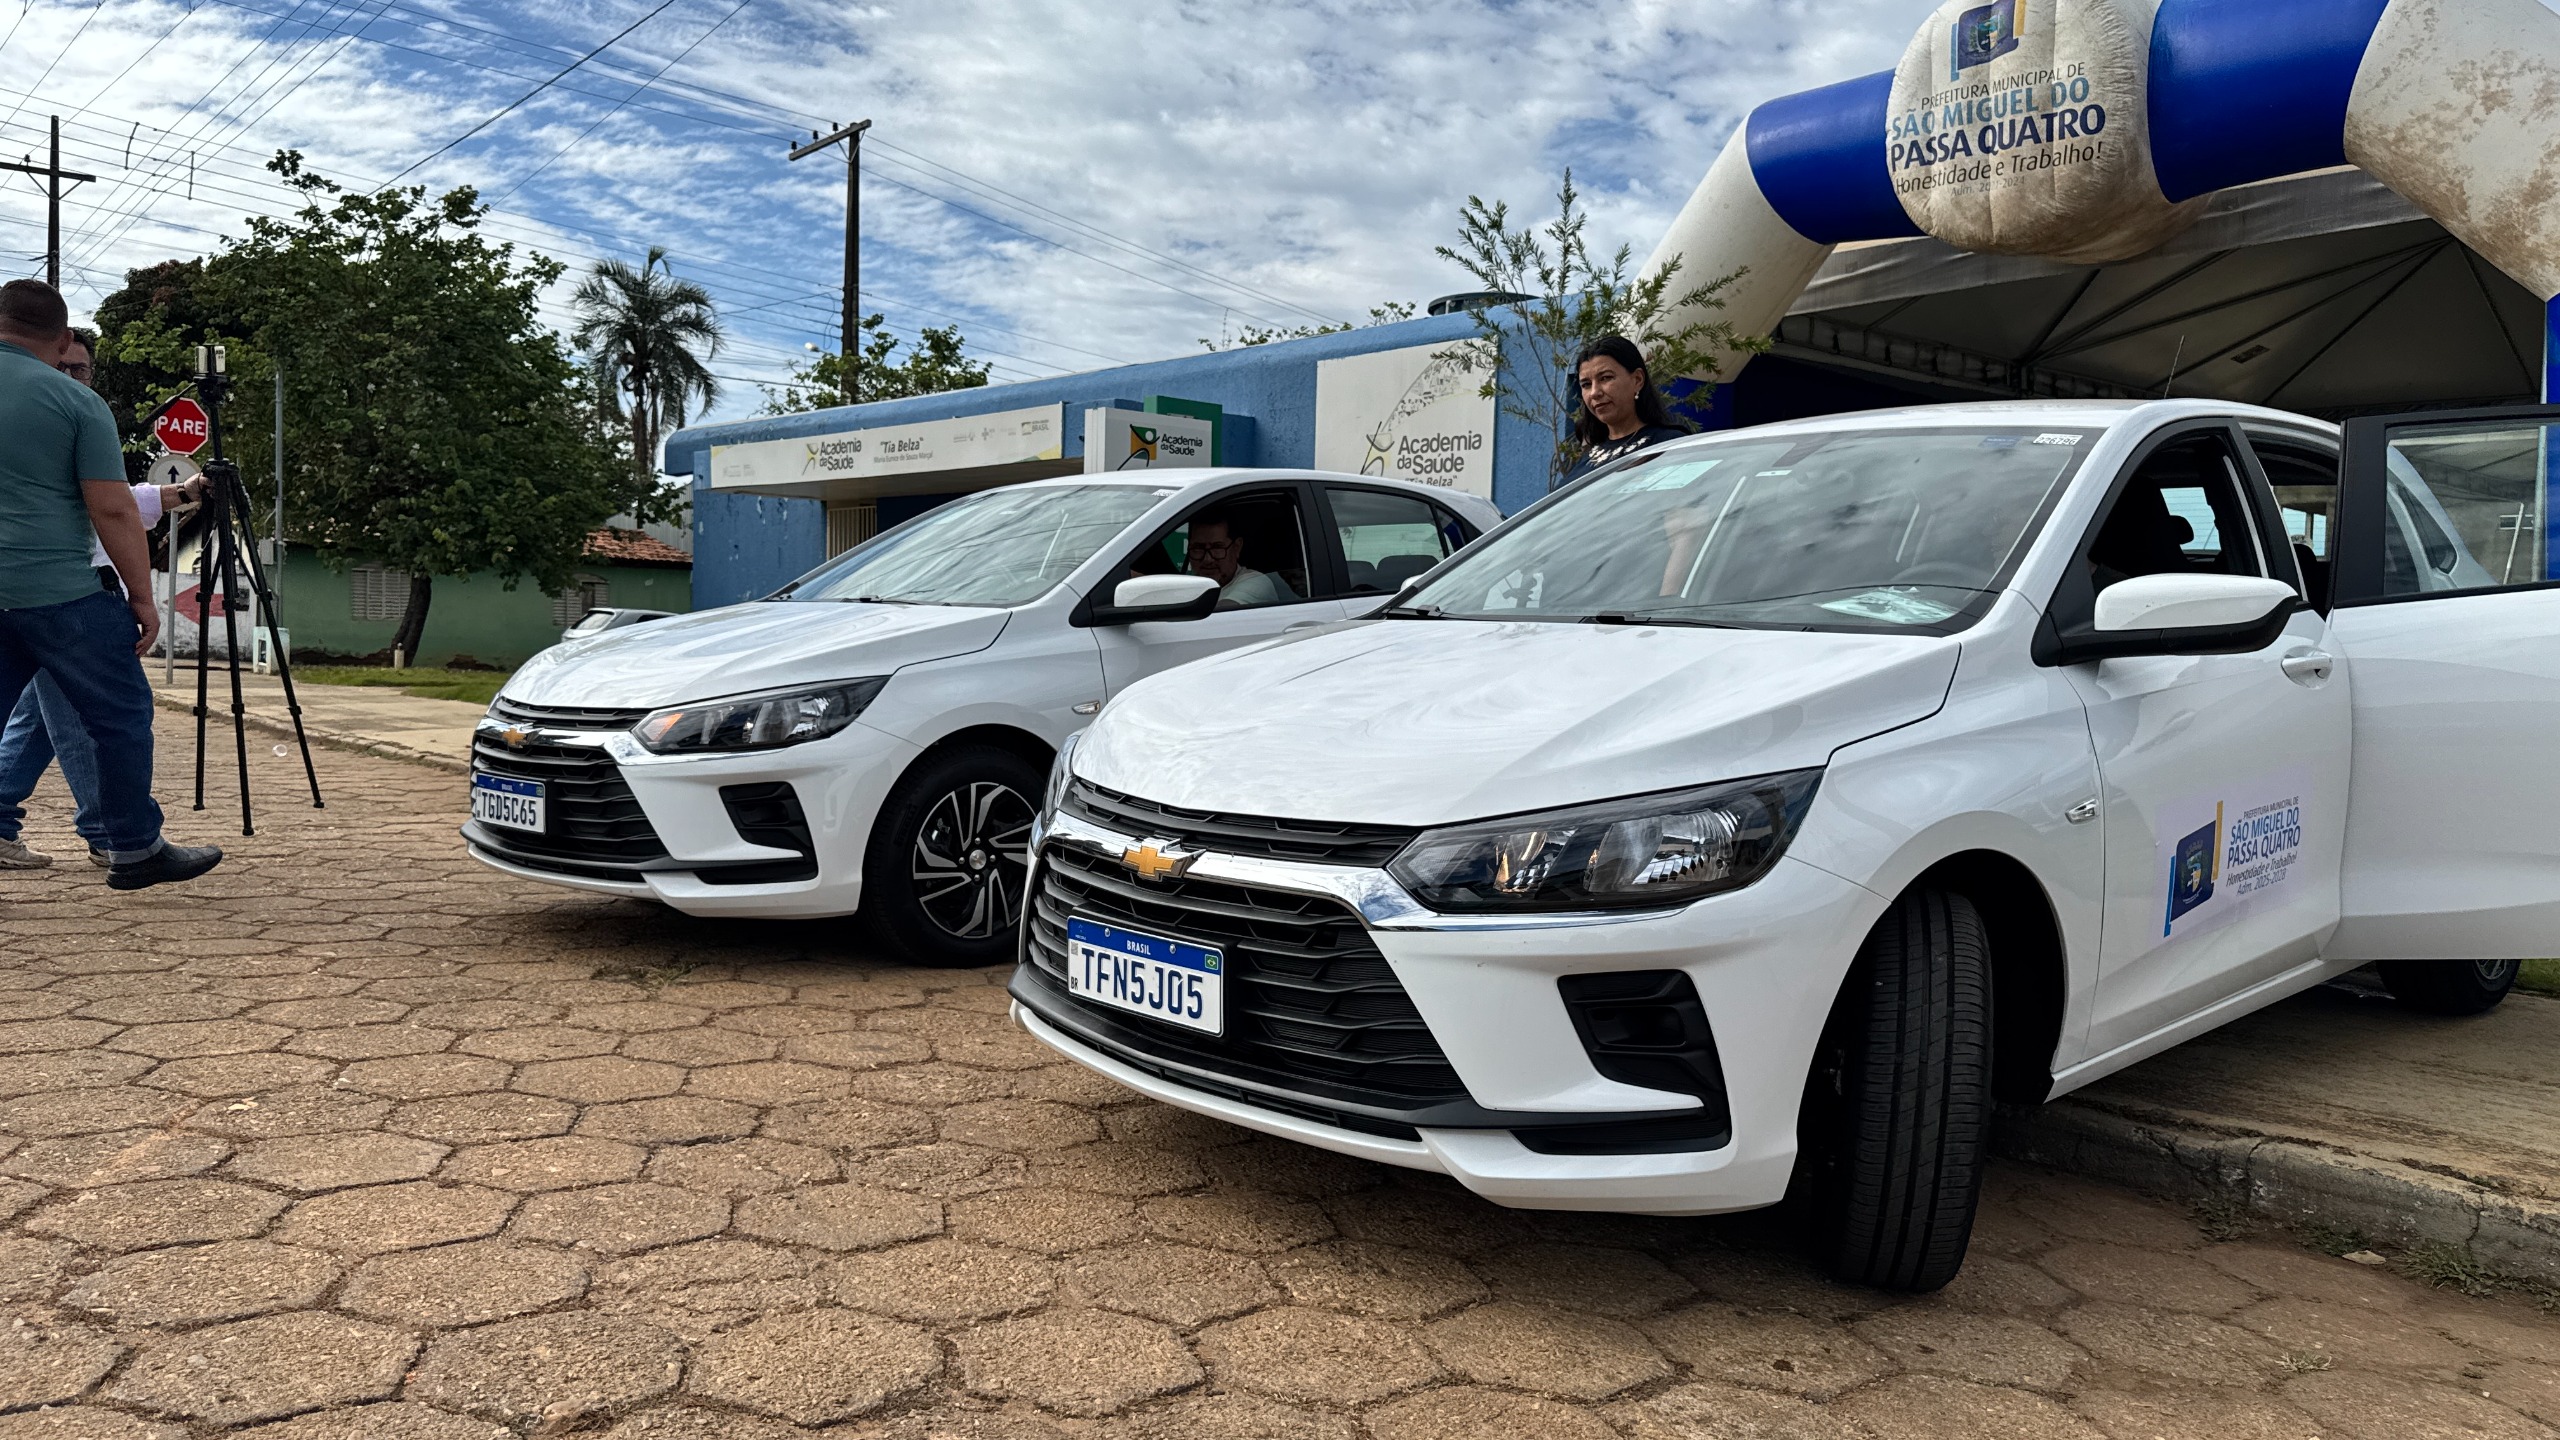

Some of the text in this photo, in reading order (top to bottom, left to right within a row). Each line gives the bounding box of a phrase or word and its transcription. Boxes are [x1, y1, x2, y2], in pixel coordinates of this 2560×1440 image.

[1921, 62, 2085, 110] PREFEITURA MUNICIPAL DE
[1892, 77, 2090, 140] SÃO MIGUEL DO
[1891, 104, 2106, 172] PASSA QUATRO
[1896, 141, 2102, 195] Honestidade e Trabalho!
[1951, 184, 1975, 197] Adm.
[158, 415, 205, 436] PARE
[820, 437, 862, 456] Academia
[1161, 433, 1203, 447] Academia
[1397, 430, 1482, 455] Academia
[819, 455, 854, 471] da Saúde
[1397, 452, 1465, 475] da Saúde
[481, 791, 537, 826] TGD5C65
[2243, 805, 2270, 819] PREFEITURA
[2293, 796, 2299, 805] DE
[2231, 807, 2299, 845] SÃO MIGUEL DO
[2227, 825, 2300, 869] PASSA QUATRO
[2226, 862, 2265, 887] Honestidade
[2270, 850, 2298, 871] Trabalho!
[1126, 939, 1151, 955] BRASIL
[1070, 976, 1079, 991] BR
[1081, 948, 1203, 1019] TFN5J05
